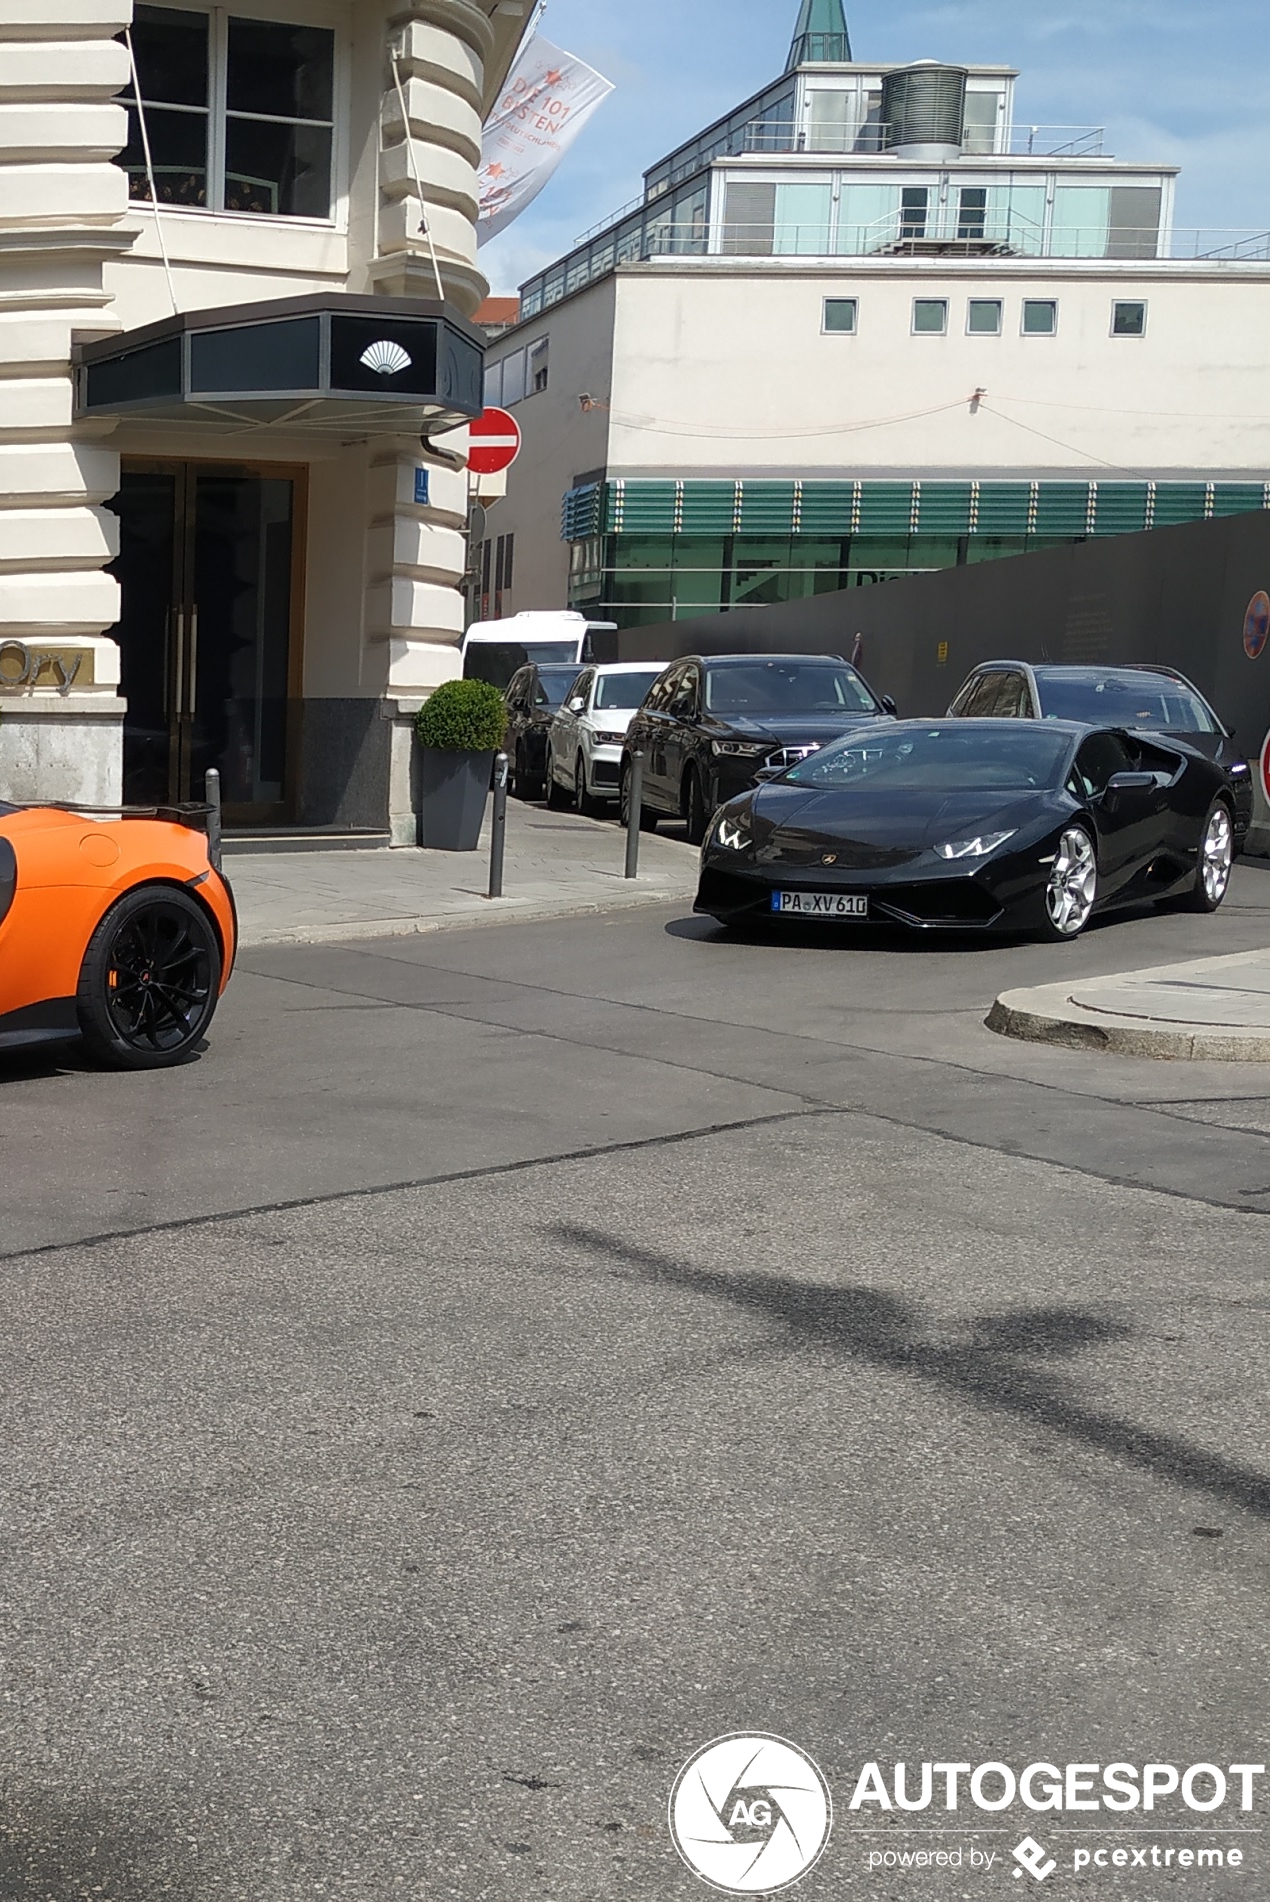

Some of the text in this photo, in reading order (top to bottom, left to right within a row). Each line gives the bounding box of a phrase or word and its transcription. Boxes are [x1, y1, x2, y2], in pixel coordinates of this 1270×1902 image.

[502, 95, 560, 134] BESTEN
[512, 77, 570, 119] DIE 101
[782, 893, 801, 910] PA
[812, 895, 833, 912] XV
[836, 896, 865, 914] 610
